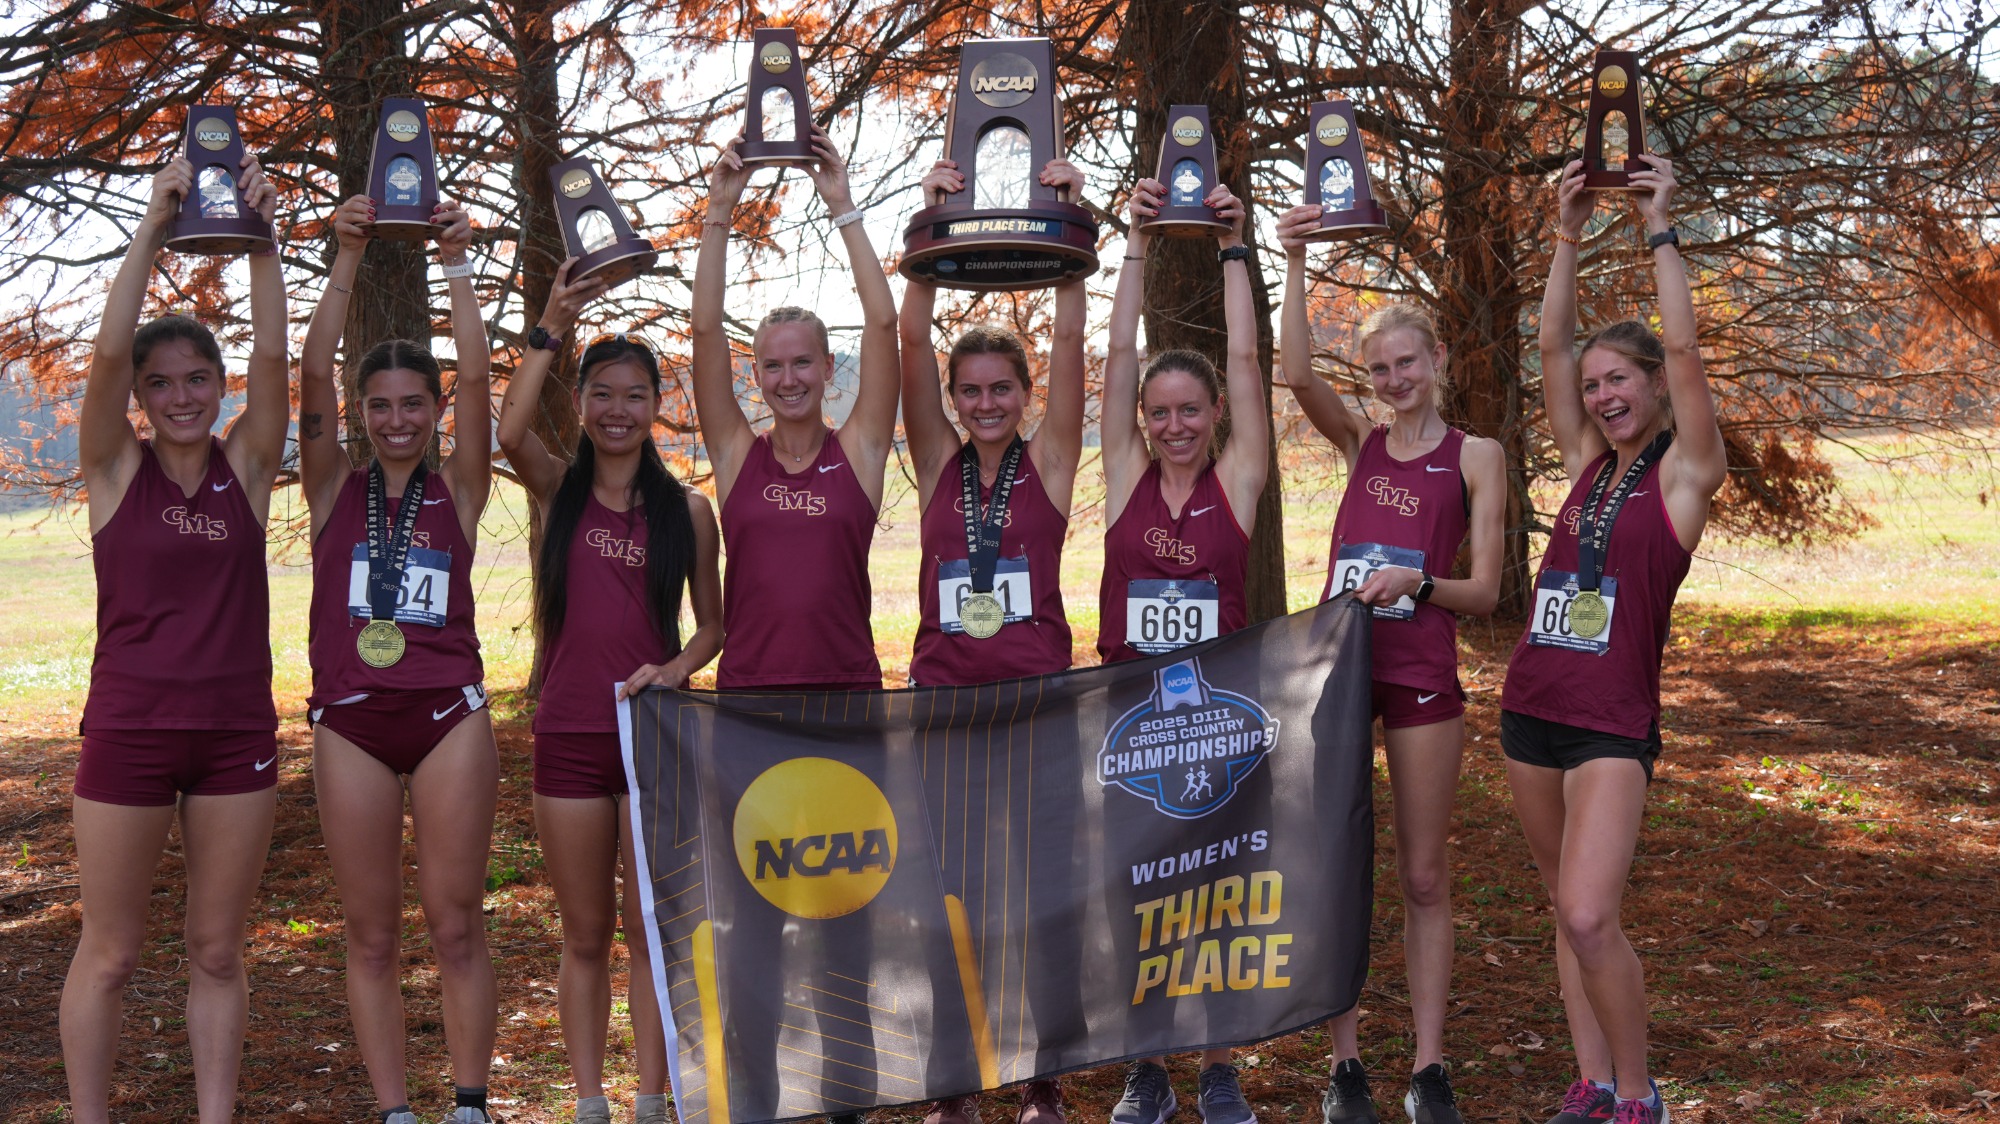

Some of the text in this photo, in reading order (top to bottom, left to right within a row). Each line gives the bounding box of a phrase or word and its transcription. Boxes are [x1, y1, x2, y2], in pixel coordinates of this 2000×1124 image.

[763, 56, 791, 65] NCAA
[975, 76, 1036, 93] NCAA
[1600, 81, 1626, 90] NCAA
[200, 131, 230, 142] NCAA
[389, 123, 419, 134] NCAA
[1175, 129, 1202, 138] NCAA
[1319, 127, 1347, 139] NCAA
[563, 178, 591, 193] NCAA
[949, 220, 1047, 235] THIRD PLACE TEAM
[965, 260, 1061, 270] CHAMPIONSHIPS
[763, 484, 826, 516] CMS
[963, 463, 977, 553] ALL-AMERICAN
[1366, 476, 1420, 516] CMS
[1593, 457, 1645, 549] ALL-AMERICAN
[1609, 501, 1622, 520] CROSS
[162, 506, 228, 541] CMS
[368, 472, 379, 558] ALL-AMERICAN
[394, 481, 424, 571] ALL-AMERICAN
[987, 510, 995, 527] NCAA
[387, 552, 395, 571] NCAA
[391, 522, 401, 550] DIVISION
[586, 528, 646, 567] CMS
[982, 539, 999, 548] 2025
[1144, 527, 1197, 565] CMS
[1580, 536, 1593, 545] 2025
[1601, 522, 1612, 552] COUNTRY
[381, 583, 399, 592] 2025
[956, 580, 1016, 618] 61
[1141, 605, 1202, 643] 669
[1167, 676, 1193, 688] NCAA
[1129, 718, 1245, 748] CROSS COUNTRY
[1140, 707, 1231, 733] 2025 DIII
[1103, 727, 1275, 776] CHAMPIONSHIPS
[755, 829, 891, 880] NCAA
[1132, 829, 1269, 886] WOMEN'S
[1134, 870, 1284, 952] THIRD
[1132, 933, 1293, 1005] PLACE
